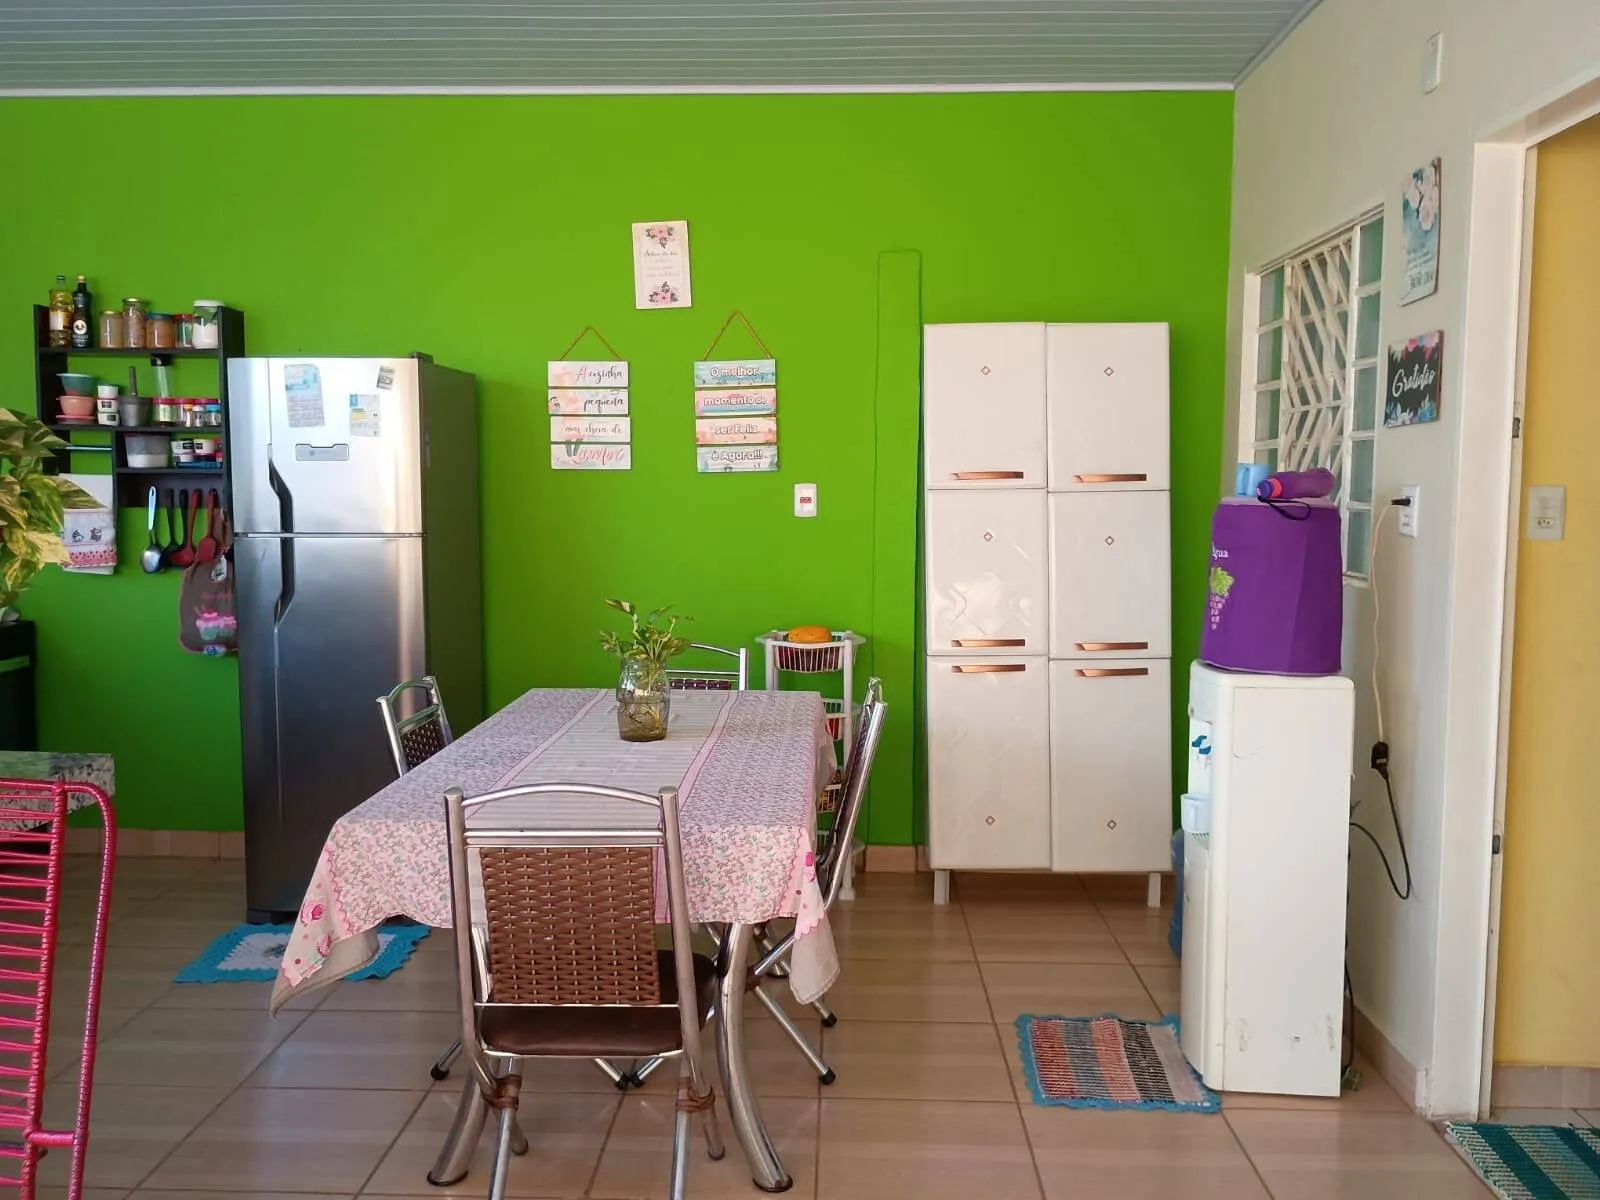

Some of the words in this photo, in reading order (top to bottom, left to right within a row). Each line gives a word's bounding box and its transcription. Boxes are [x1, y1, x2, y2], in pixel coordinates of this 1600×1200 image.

[589, 365, 624, 385] cozinha
[710, 366, 720, 378] O
[721, 365, 759, 377] melhor
[583, 397, 625, 414] pequena
